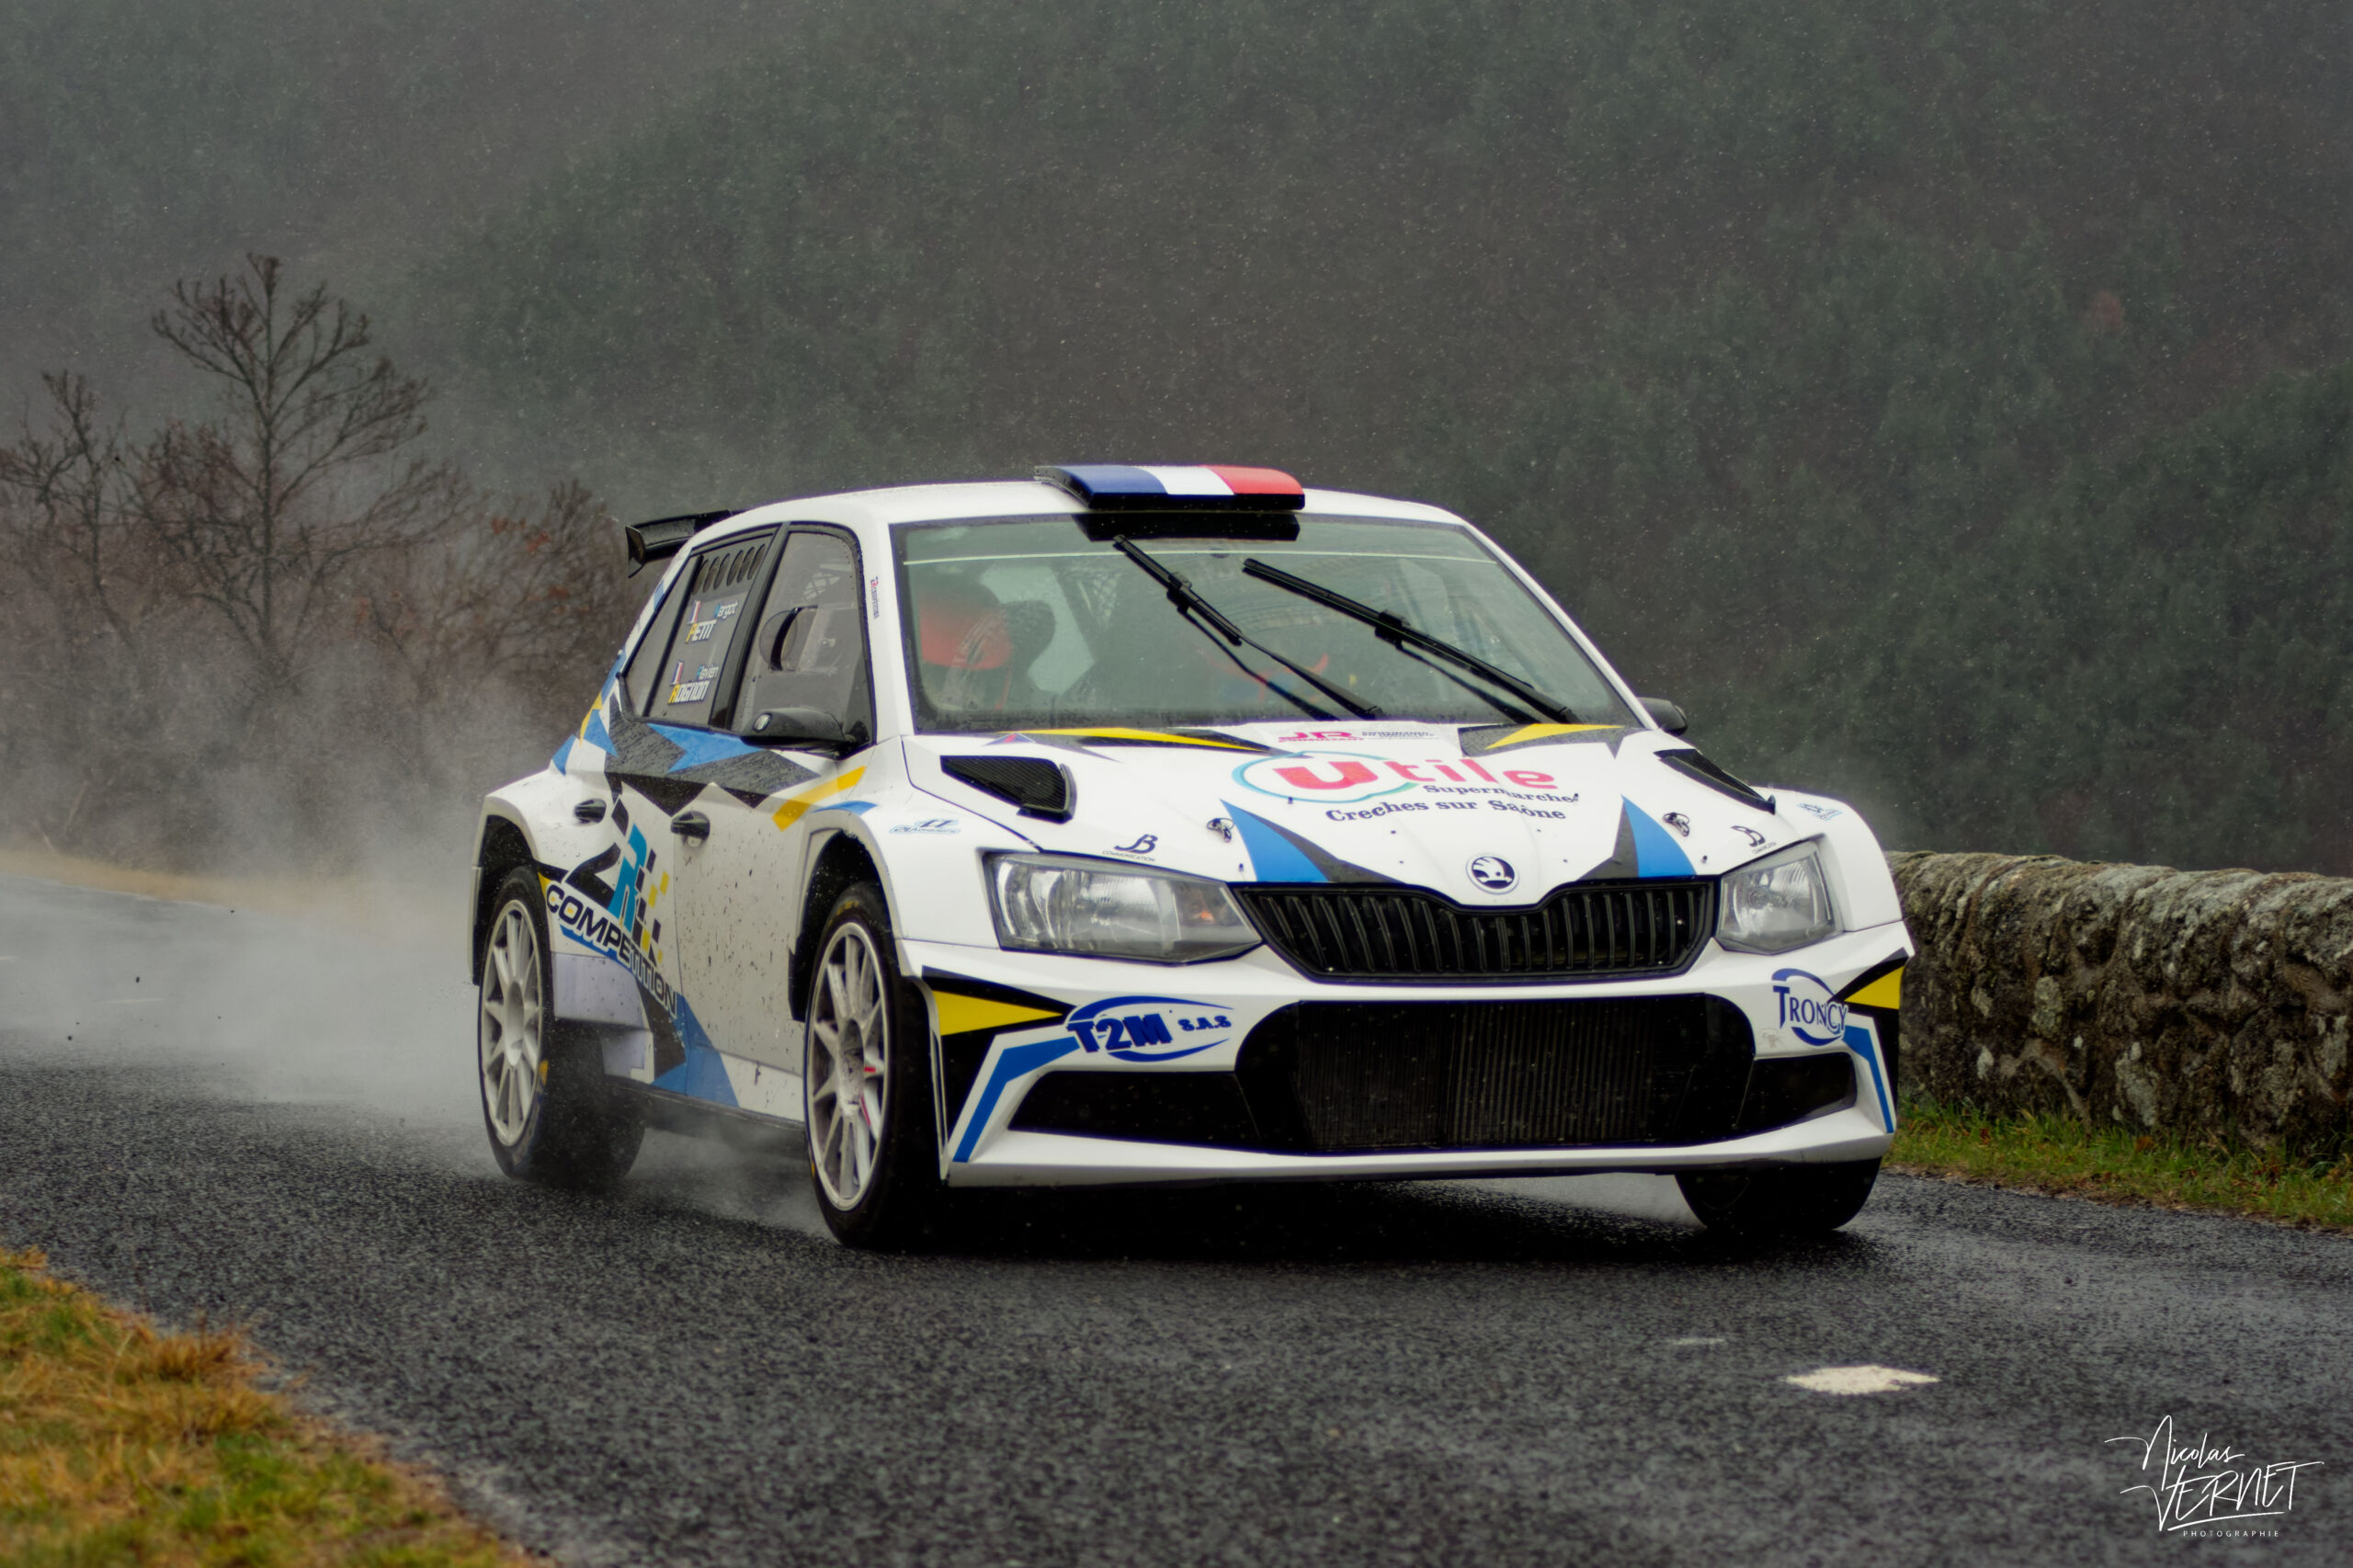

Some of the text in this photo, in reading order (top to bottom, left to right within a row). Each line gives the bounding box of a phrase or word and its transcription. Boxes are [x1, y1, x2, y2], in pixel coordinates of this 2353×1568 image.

[1325, 801, 1429, 822] Creches
[1435, 801, 1478, 811] sur
[545, 882, 677, 1017] COMPETITION
[1772, 984, 1849, 1031] TRONCY
[1066, 1014, 1173, 1053] T2M
